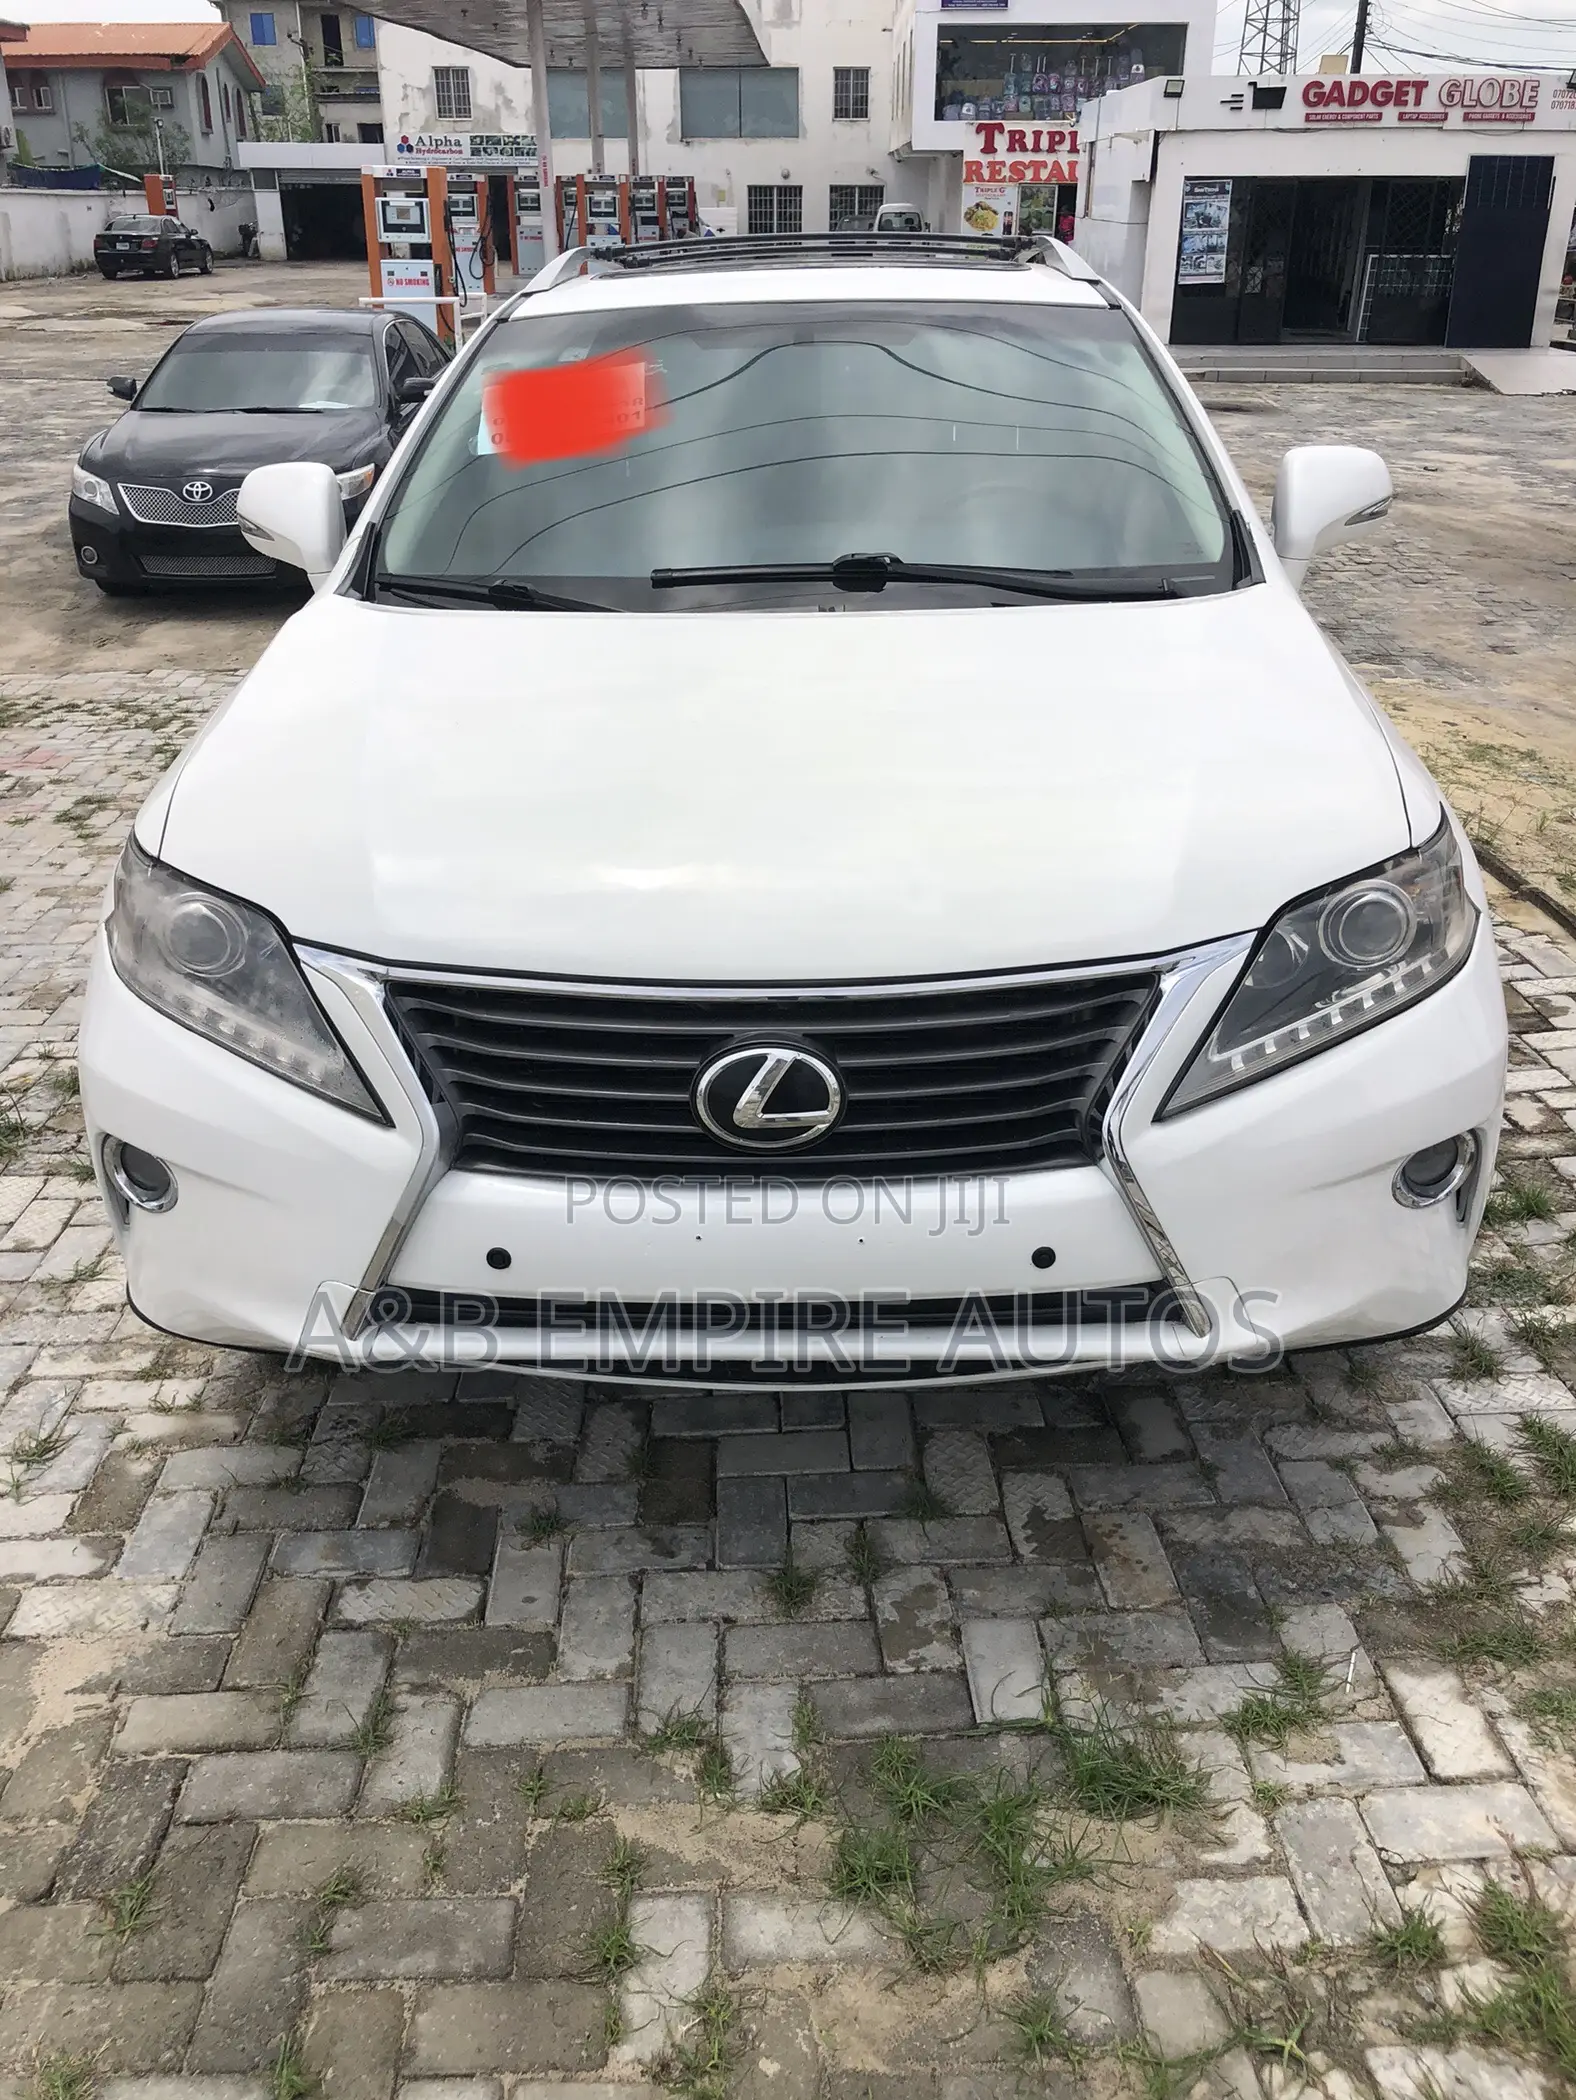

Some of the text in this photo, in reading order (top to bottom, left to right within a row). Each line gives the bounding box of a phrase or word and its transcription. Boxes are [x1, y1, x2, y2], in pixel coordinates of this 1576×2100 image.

[1302, 78, 1540, 108] GADGET GLOBE
[415, 136, 463, 149] Alpha
[415, 147, 463, 156] Hydrocarbon
[395, 278, 430, 286] NO SMOKING
